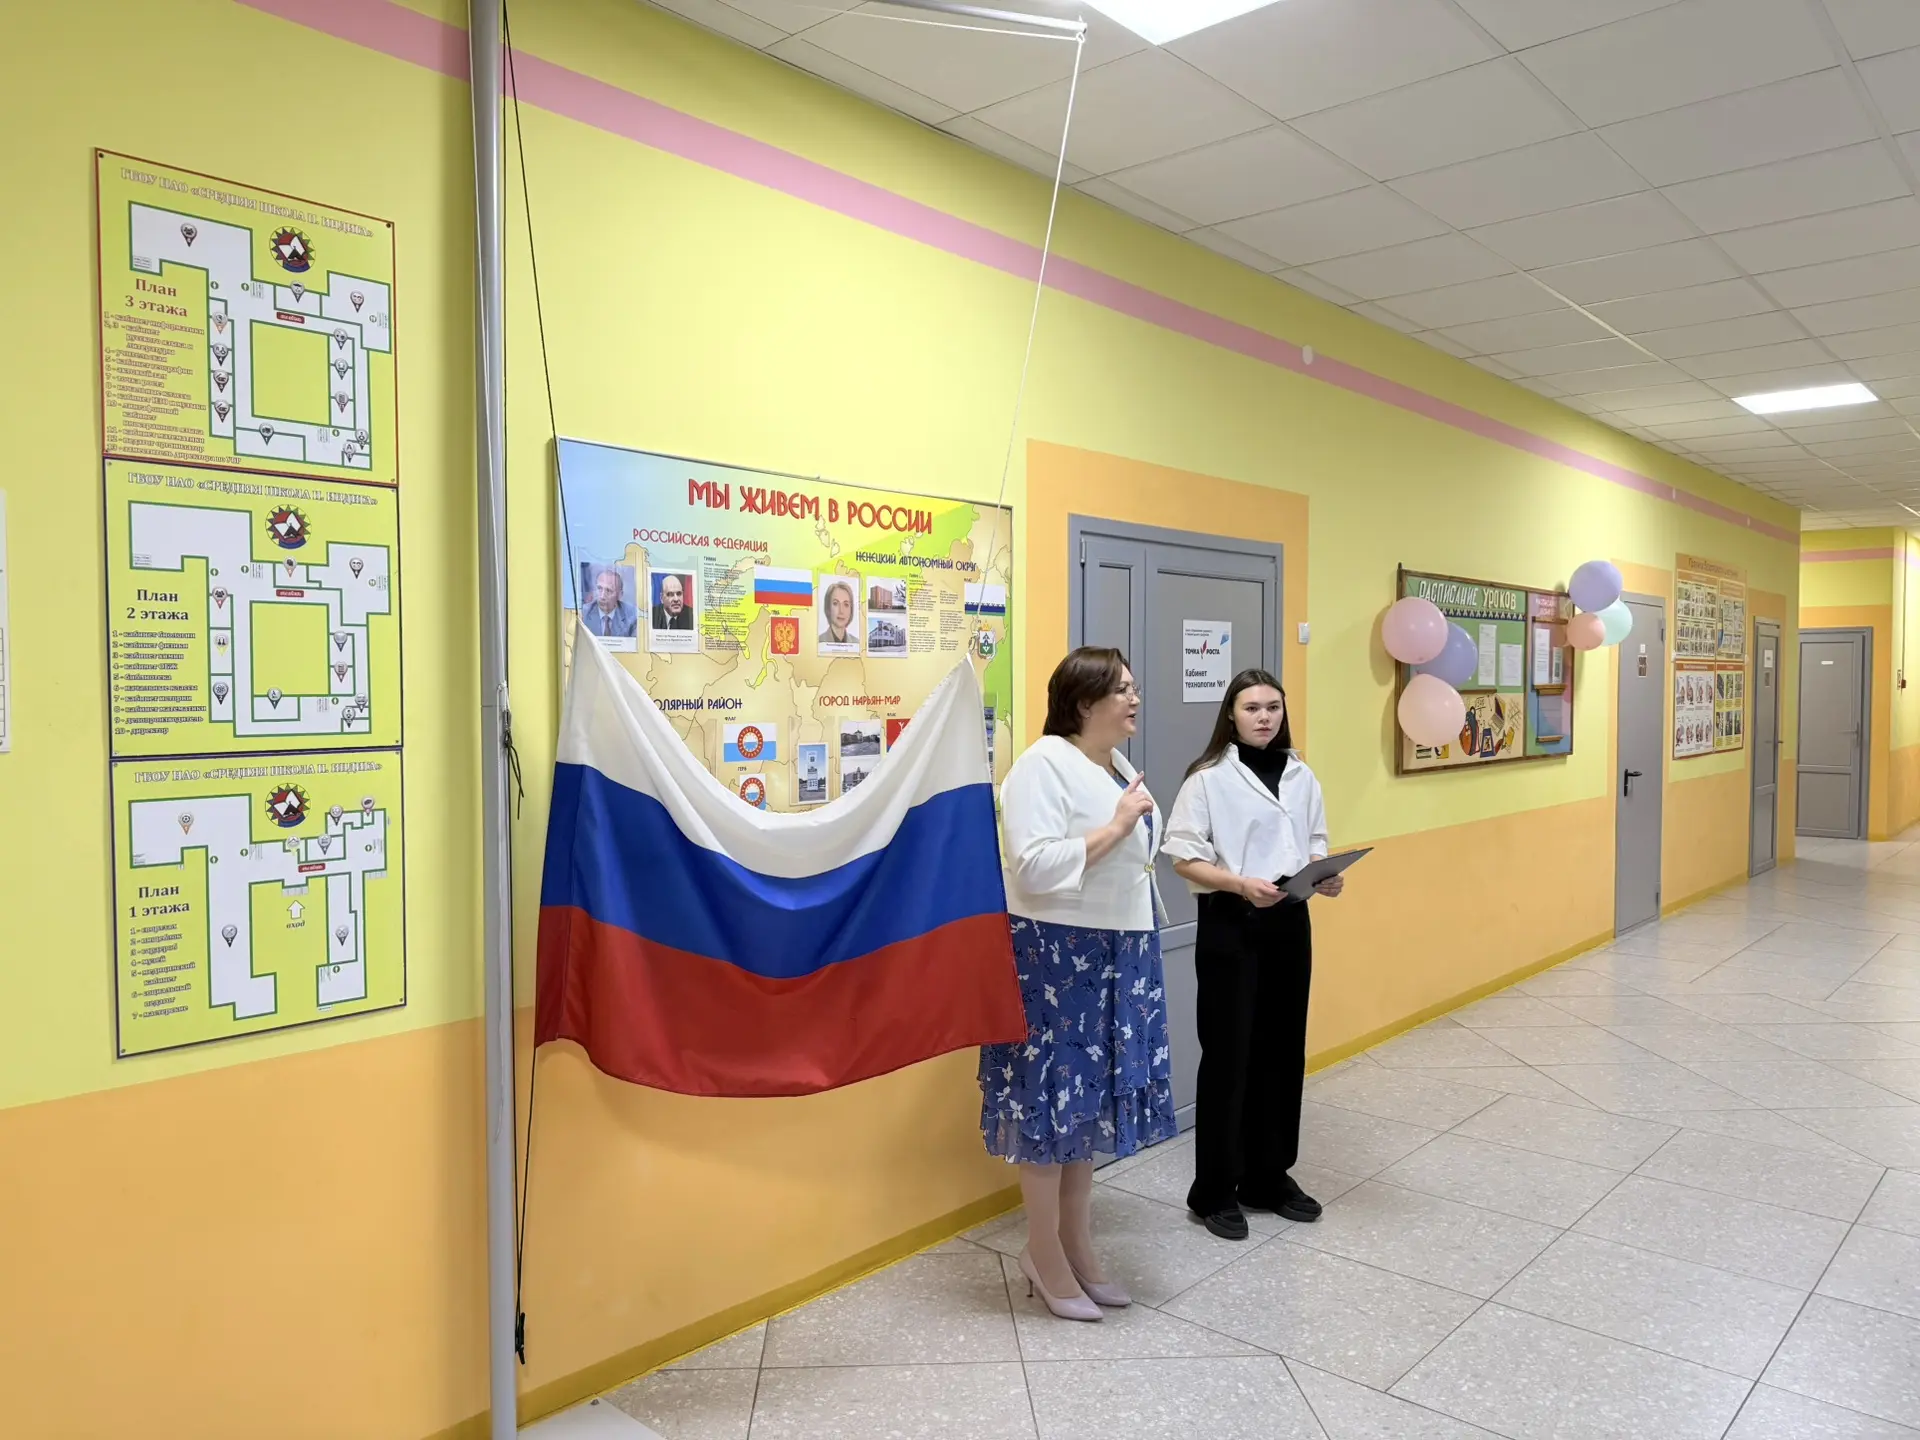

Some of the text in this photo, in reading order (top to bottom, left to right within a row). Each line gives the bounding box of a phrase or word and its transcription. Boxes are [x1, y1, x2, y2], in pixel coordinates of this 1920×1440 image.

[135, 278, 176, 296] План
[125, 294, 187, 316] 3 этажа
[128, 472, 165, 486] ГБОУ
[688, 479, 932, 534] МЫ ЖИВЕМ В РОССИИ
[633, 528, 768, 552] РОССИЙСКАЯ ФЕДЕРАЦИЯ
[856, 551, 976, 572] НЕНЕЦКИЙ АВТОНОМНЫЙ ОКРУГ
[137, 589, 178, 602] План
[1419, 581, 1479, 606] РАСПИСАНИЕ
[1482, 589, 1516, 610] УРОКОВ
[126, 607, 188, 620] 2 этажа
[1185, 669, 1207, 677] Кабинет
[1217, 680, 1225, 688] №1
[708, 697, 742, 709] РАЙОН
[819, 695, 901, 706] ГОРОД НАРЬЯН-МАР
[135, 770, 170, 783] ГБОУ
[138, 885, 179, 898] План
[129, 902, 189, 917] 1 этажа
